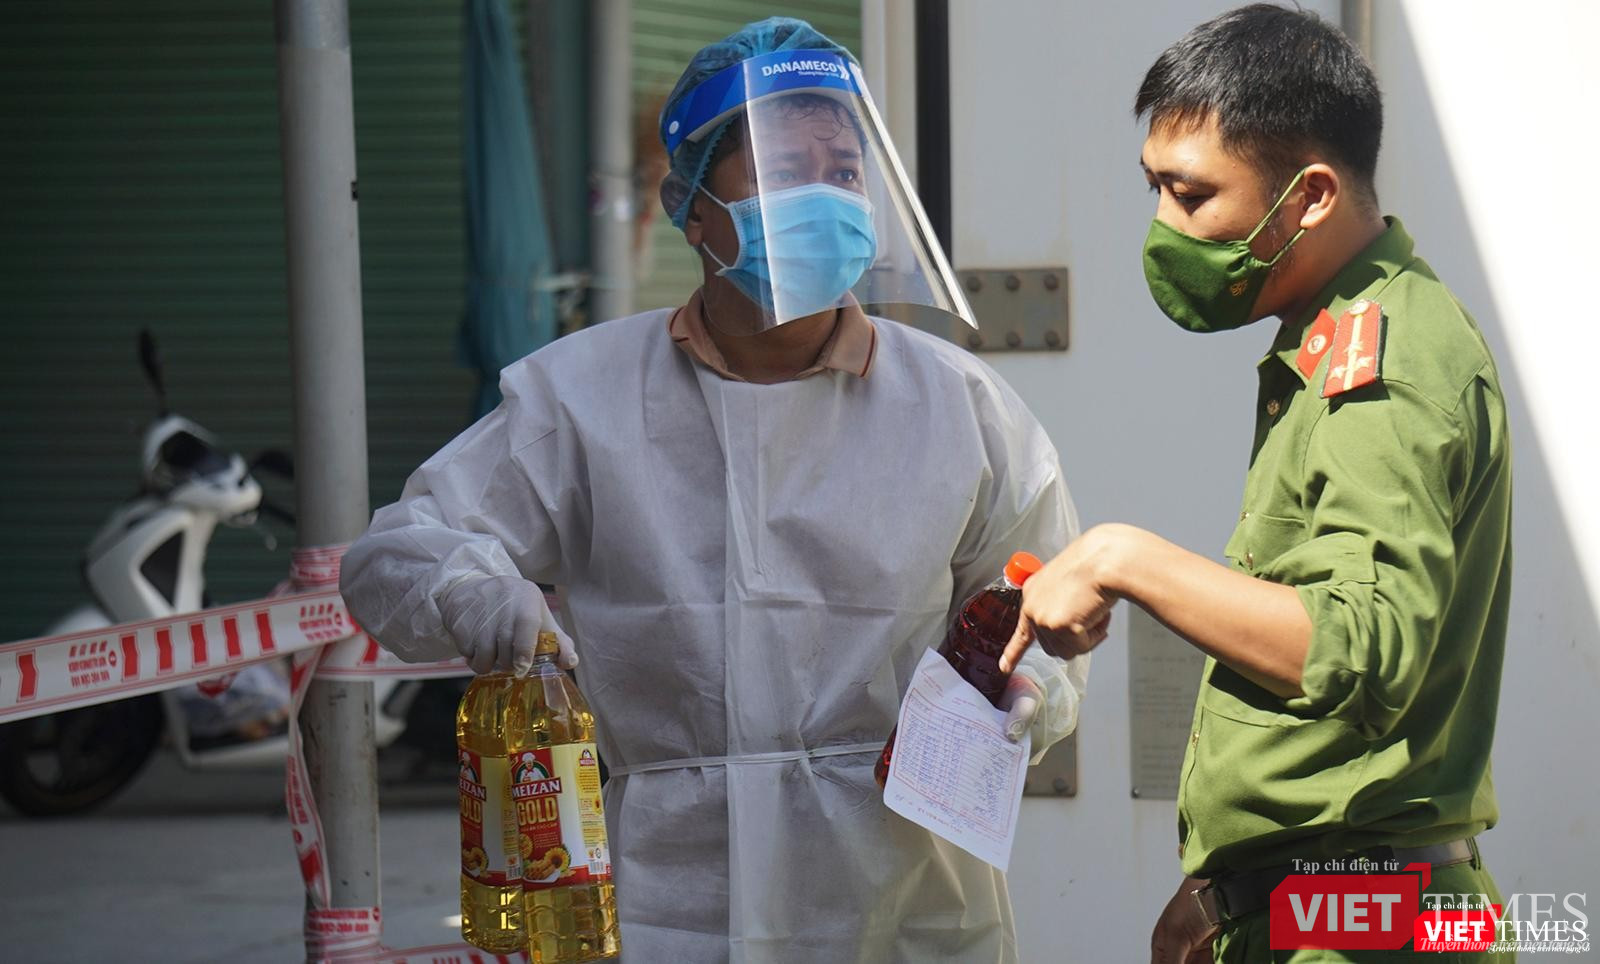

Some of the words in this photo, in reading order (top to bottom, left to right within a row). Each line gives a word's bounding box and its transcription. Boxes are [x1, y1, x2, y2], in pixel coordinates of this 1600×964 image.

[761, 60, 837, 77] DANAMECO
[512, 780, 560, 797] MEIZAN
[517, 797, 557, 825] GOLD
